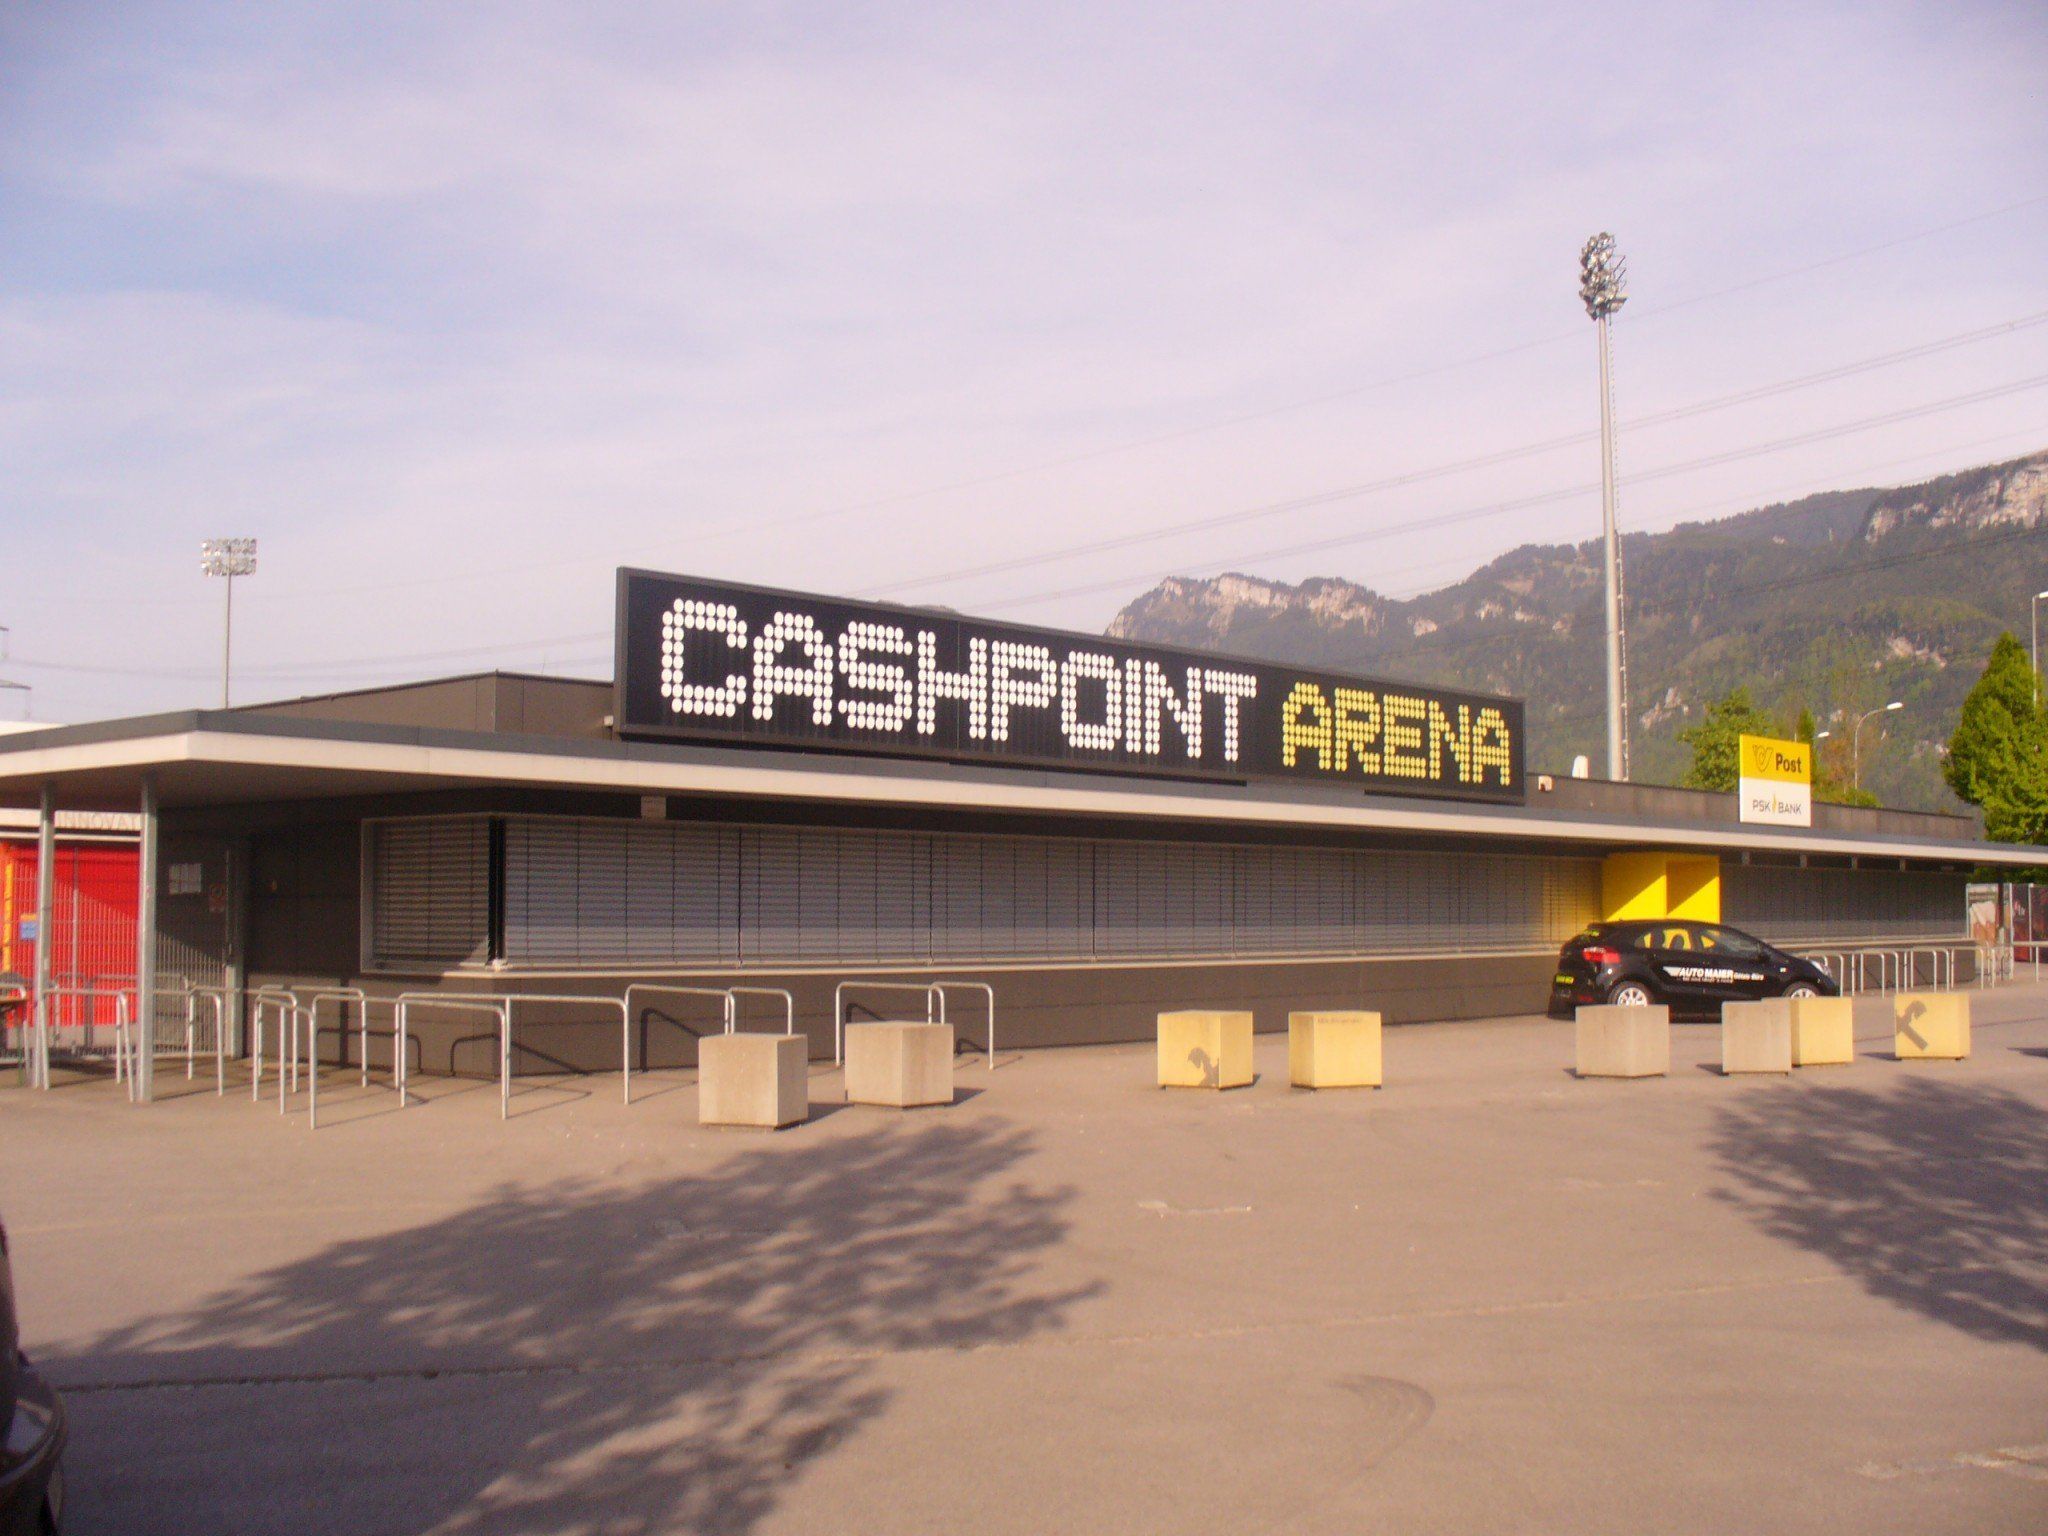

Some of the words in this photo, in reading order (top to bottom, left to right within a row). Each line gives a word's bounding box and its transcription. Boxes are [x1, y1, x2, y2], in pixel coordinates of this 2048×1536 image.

[661, 598, 1257, 762] CASHPOINT
[1282, 682, 1511, 786] ARENA
[1775, 752, 1802, 774] Post
[1752, 799, 1771, 812] PSK
[1778, 802, 1802, 815] BANK
[1679, 967, 1704, 977] AUTO
[1704, 968, 1734, 980] MAIER
